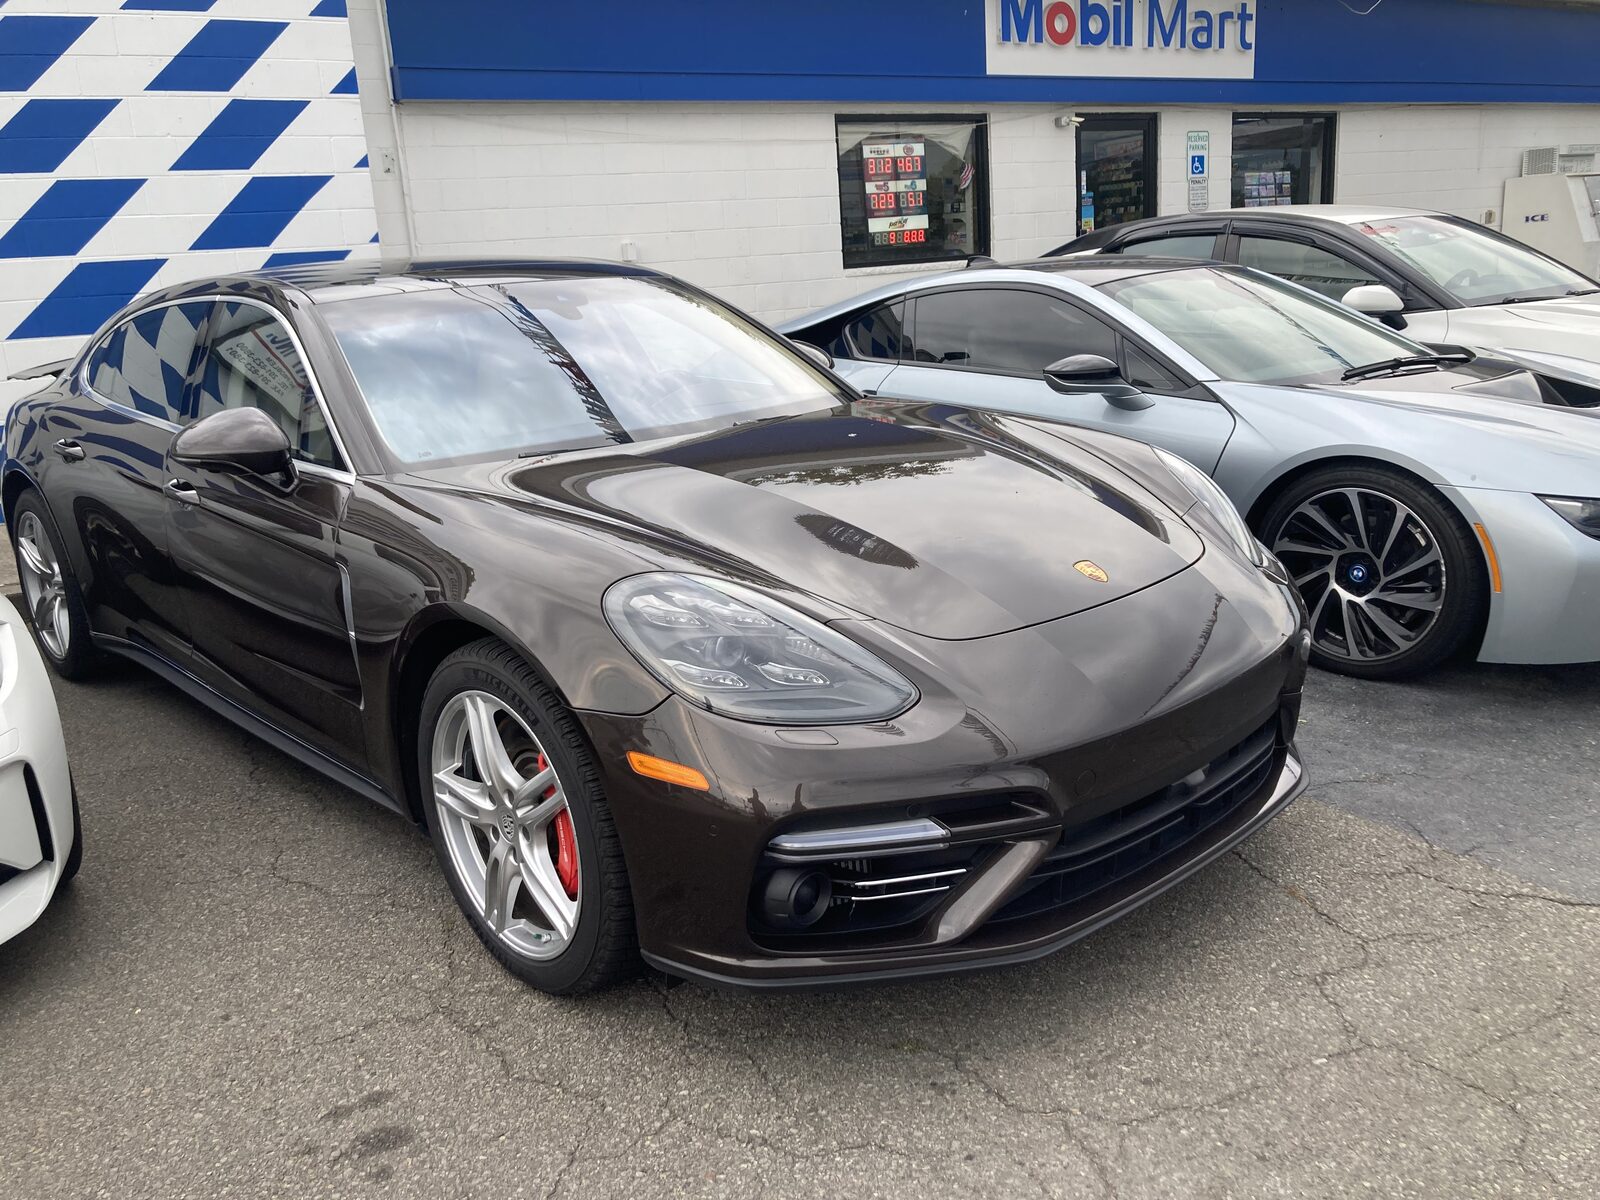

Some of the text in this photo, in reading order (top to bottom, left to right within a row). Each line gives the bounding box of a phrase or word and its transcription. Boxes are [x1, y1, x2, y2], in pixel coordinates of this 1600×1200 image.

[1000, 0, 1254, 50] Mobil Mart
[1189, 143, 1207, 151] PARKING
[897, 156, 921, 172] 467
[1525, 213, 1549, 222] ICE
